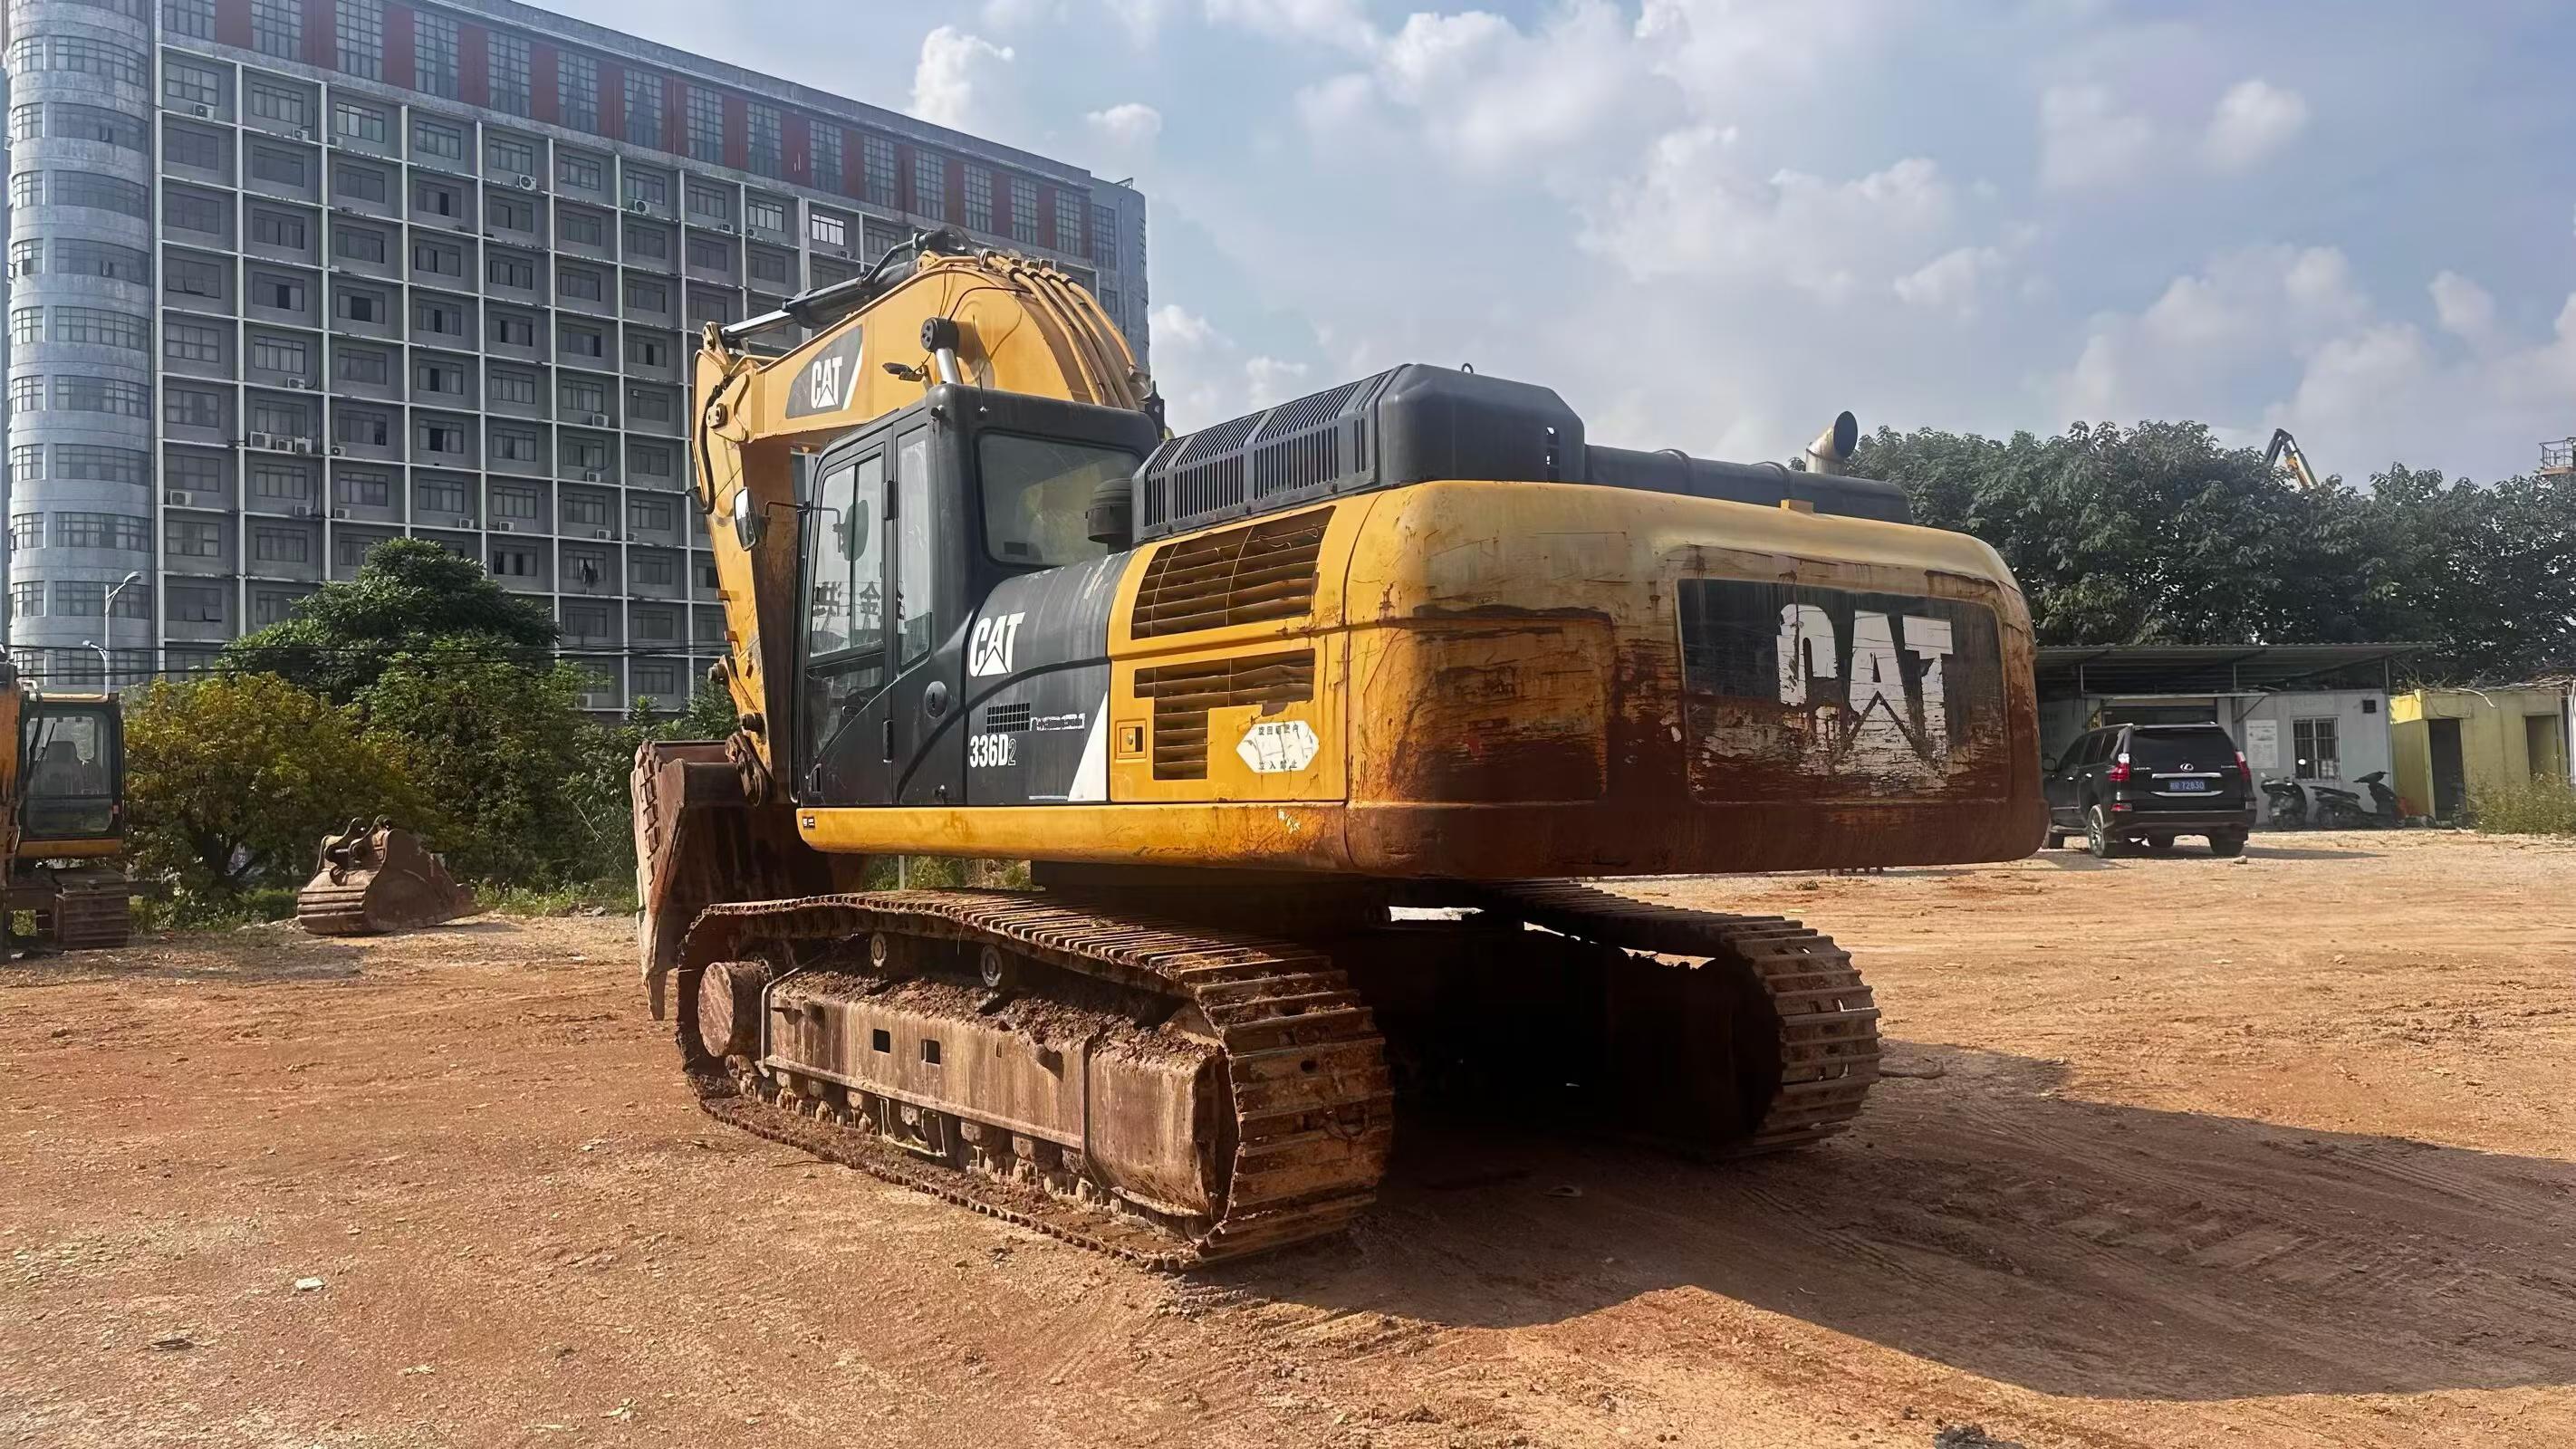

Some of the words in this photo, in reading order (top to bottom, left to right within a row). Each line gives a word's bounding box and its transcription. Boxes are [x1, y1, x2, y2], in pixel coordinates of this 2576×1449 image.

[811, 356, 842, 409] CAT
[969, 611, 1025, 677] CAT
[969, 734, 1016, 768] 336D2
